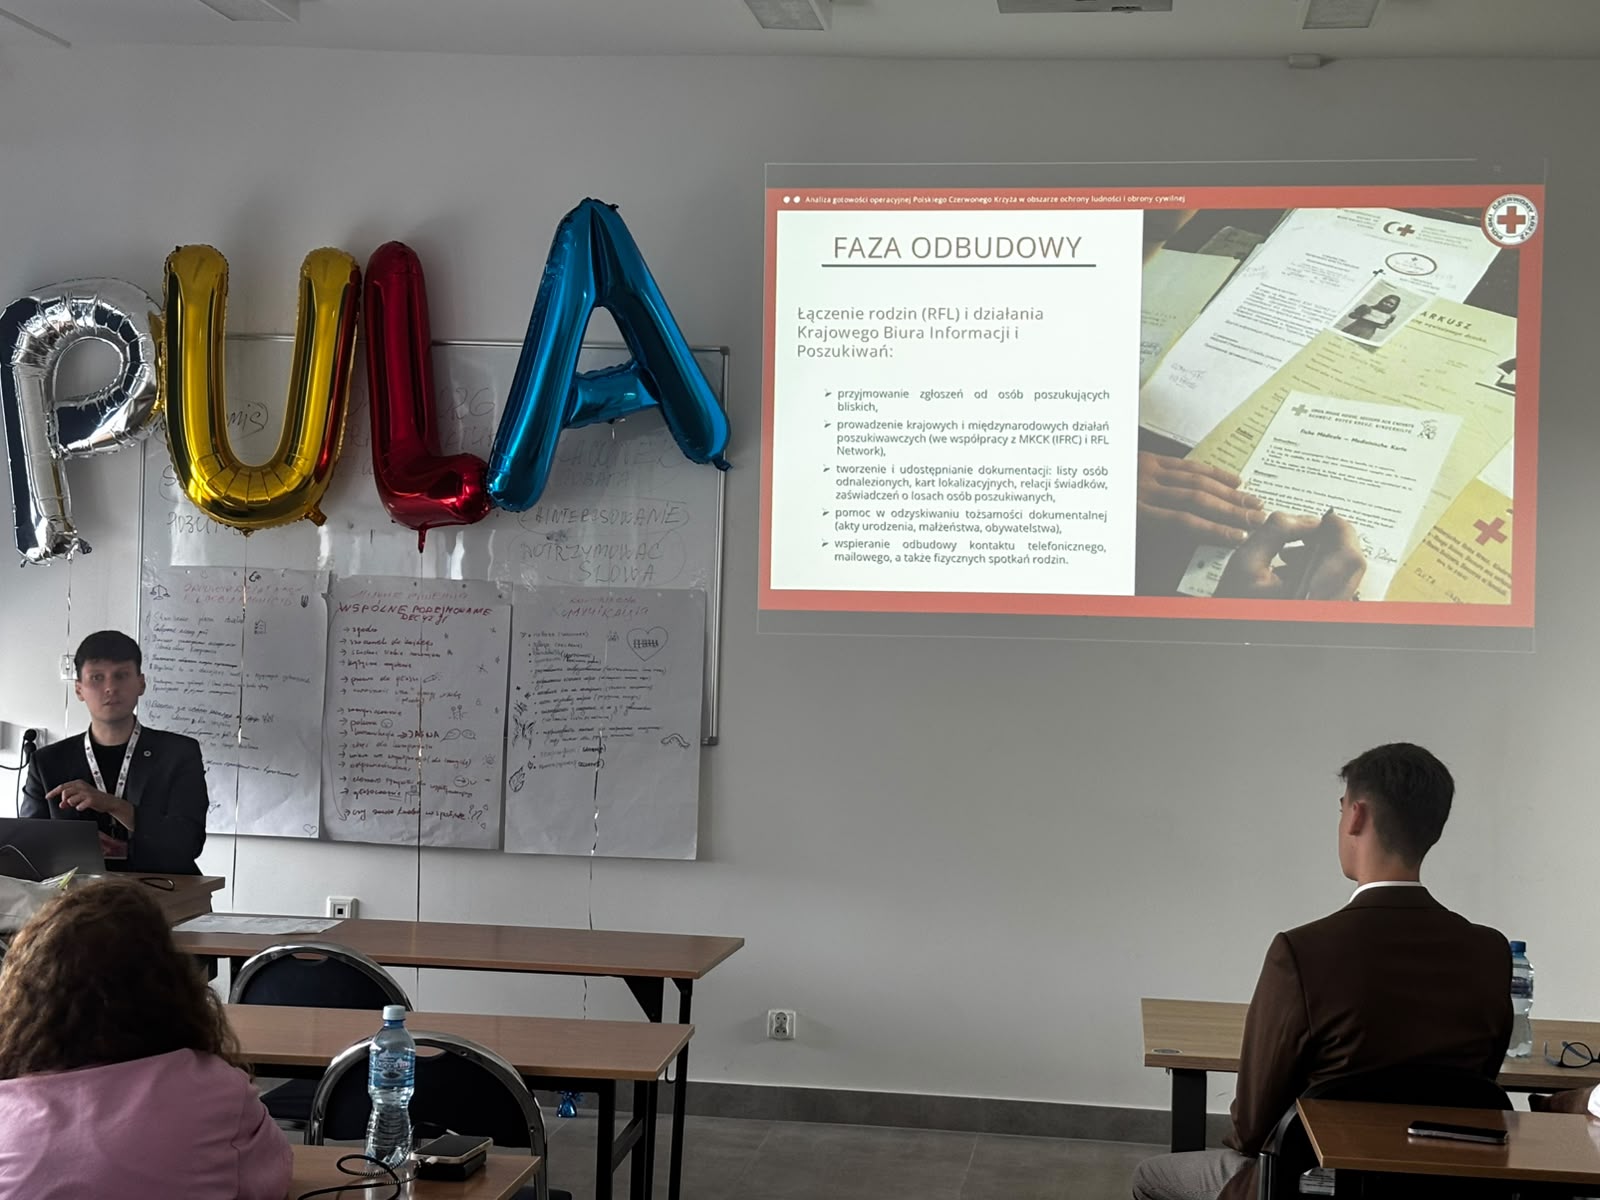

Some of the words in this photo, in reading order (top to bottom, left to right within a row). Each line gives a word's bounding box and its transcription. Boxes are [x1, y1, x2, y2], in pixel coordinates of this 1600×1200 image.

[832, 195, 868, 205] gotowości
[870, 196, 911, 205] operacyjnej
[913, 194, 947, 204] Polskiego
[948, 195, 991, 204] Czerwonego
[994, 195, 1018, 204] Krzyża
[1027, 195, 1058, 203] obszarze
[1060, 195, 1089, 204] ochrony
[1091, 194, 1122, 203] ludności
[1127, 195, 1153, 204] obrony
[1155, 194, 1186, 204] cywilnej
[834, 236, 902, 259] FAZA
[911, 235, 1082, 259] ODBUDOWY
[797, 306, 864, 324] Łączenie
[868, 306, 917, 320] rodzin
[921, 307, 960, 324] (RFL)
[964, 307, 969, 320] i
[973, 307, 1044, 321] działania
[1420, 310, 1474, 330] ARKUSZ
[797, 326, 879, 343] Krajowego
[884, 326, 925, 340] Biura
[929, 326, 1010, 343] Informacji
[1015, 326, 1019, 339] i
[797, 344, 894, 358] Poszukiwań:
[837, 389, 910, 401] przyjmowanie
[920, 389, 964, 402] zgłoszeń
[974, 389, 988, 400] od
[998, 389, 1024, 400] osób
[1034, 389, 1110, 403] poszukujących
[837, 401, 879, 413] bliskich,
[837, 420, 903, 432] prowadzenie
[906, 420, 958, 434] krajowych
[961, 420, 965, 430] i
[968, 420, 1069, 435] międzynarodowych
[1072, 420, 1109, 432] działań
[836, 433, 926, 446] poszukiwawczych
[928, 434, 947, 446] (we
[950, 434, 1008, 447] współpracy
[1011, 436, 1016, 444] z
[1019, 434, 1050, 444] MKCK
[1052, 434, 1082, 447] (IFRC)
[1084, 434, 1088, 445] i
[1090, 434, 1109, 445] RFL
[836, 446, 886, 458] Network),
[836, 464, 887, 475] tworzenie
[891, 464, 895, 475] i
[899, 464, 973, 478] udostępnianie
[978, 464, 1052, 478] dokumentacji:
[1056, 465, 1078, 479] listy
[1082, 465, 1108, 477] osób
[835, 477, 912, 490] odnalezionych,
[914, 477, 936, 488] kart
[938, 477, 1017, 491] lokalizacyjnych,
[1020, 478, 1051, 491] relacji
[1054, 478, 1108, 490] świadków,
[835, 490, 899, 501] zaświadczeń
[902, 493, 909, 501] o
[911, 490, 944, 501] losach
[946, 491, 972, 502] osób
[974, 491, 1056, 504] poszukiwanych,
[835, 510, 871, 521] pomoc
[875, 511, 885, 519] w
[890, 508, 960, 522] odzyskiwaniu
[965, 509, 1023, 520] tożsamości
[1029, 509, 1107, 524] dokumentalnej
[834, 521, 860, 534] (akty
[862, 521, 916, 534] urodzenia,
[919, 522, 983, 534] małżeństwa,
[985, 523, 1062, 536] obywatelstwa),
[834, 539, 890, 552] wspieranie
[902, 540, 957, 553] odbudowy
[969, 540, 1015, 551] kontaktu
[1027, 540, 1106, 555] telefonicznego,
[834, 551, 893, 565] mailowego,
[894, 555, 901, 563] a
[903, 552, 931, 563] także
[934, 553, 986, 566] fizycznych
[988, 554, 1030, 567] spotkań
[1032, 554, 1069, 565] rodzin.
